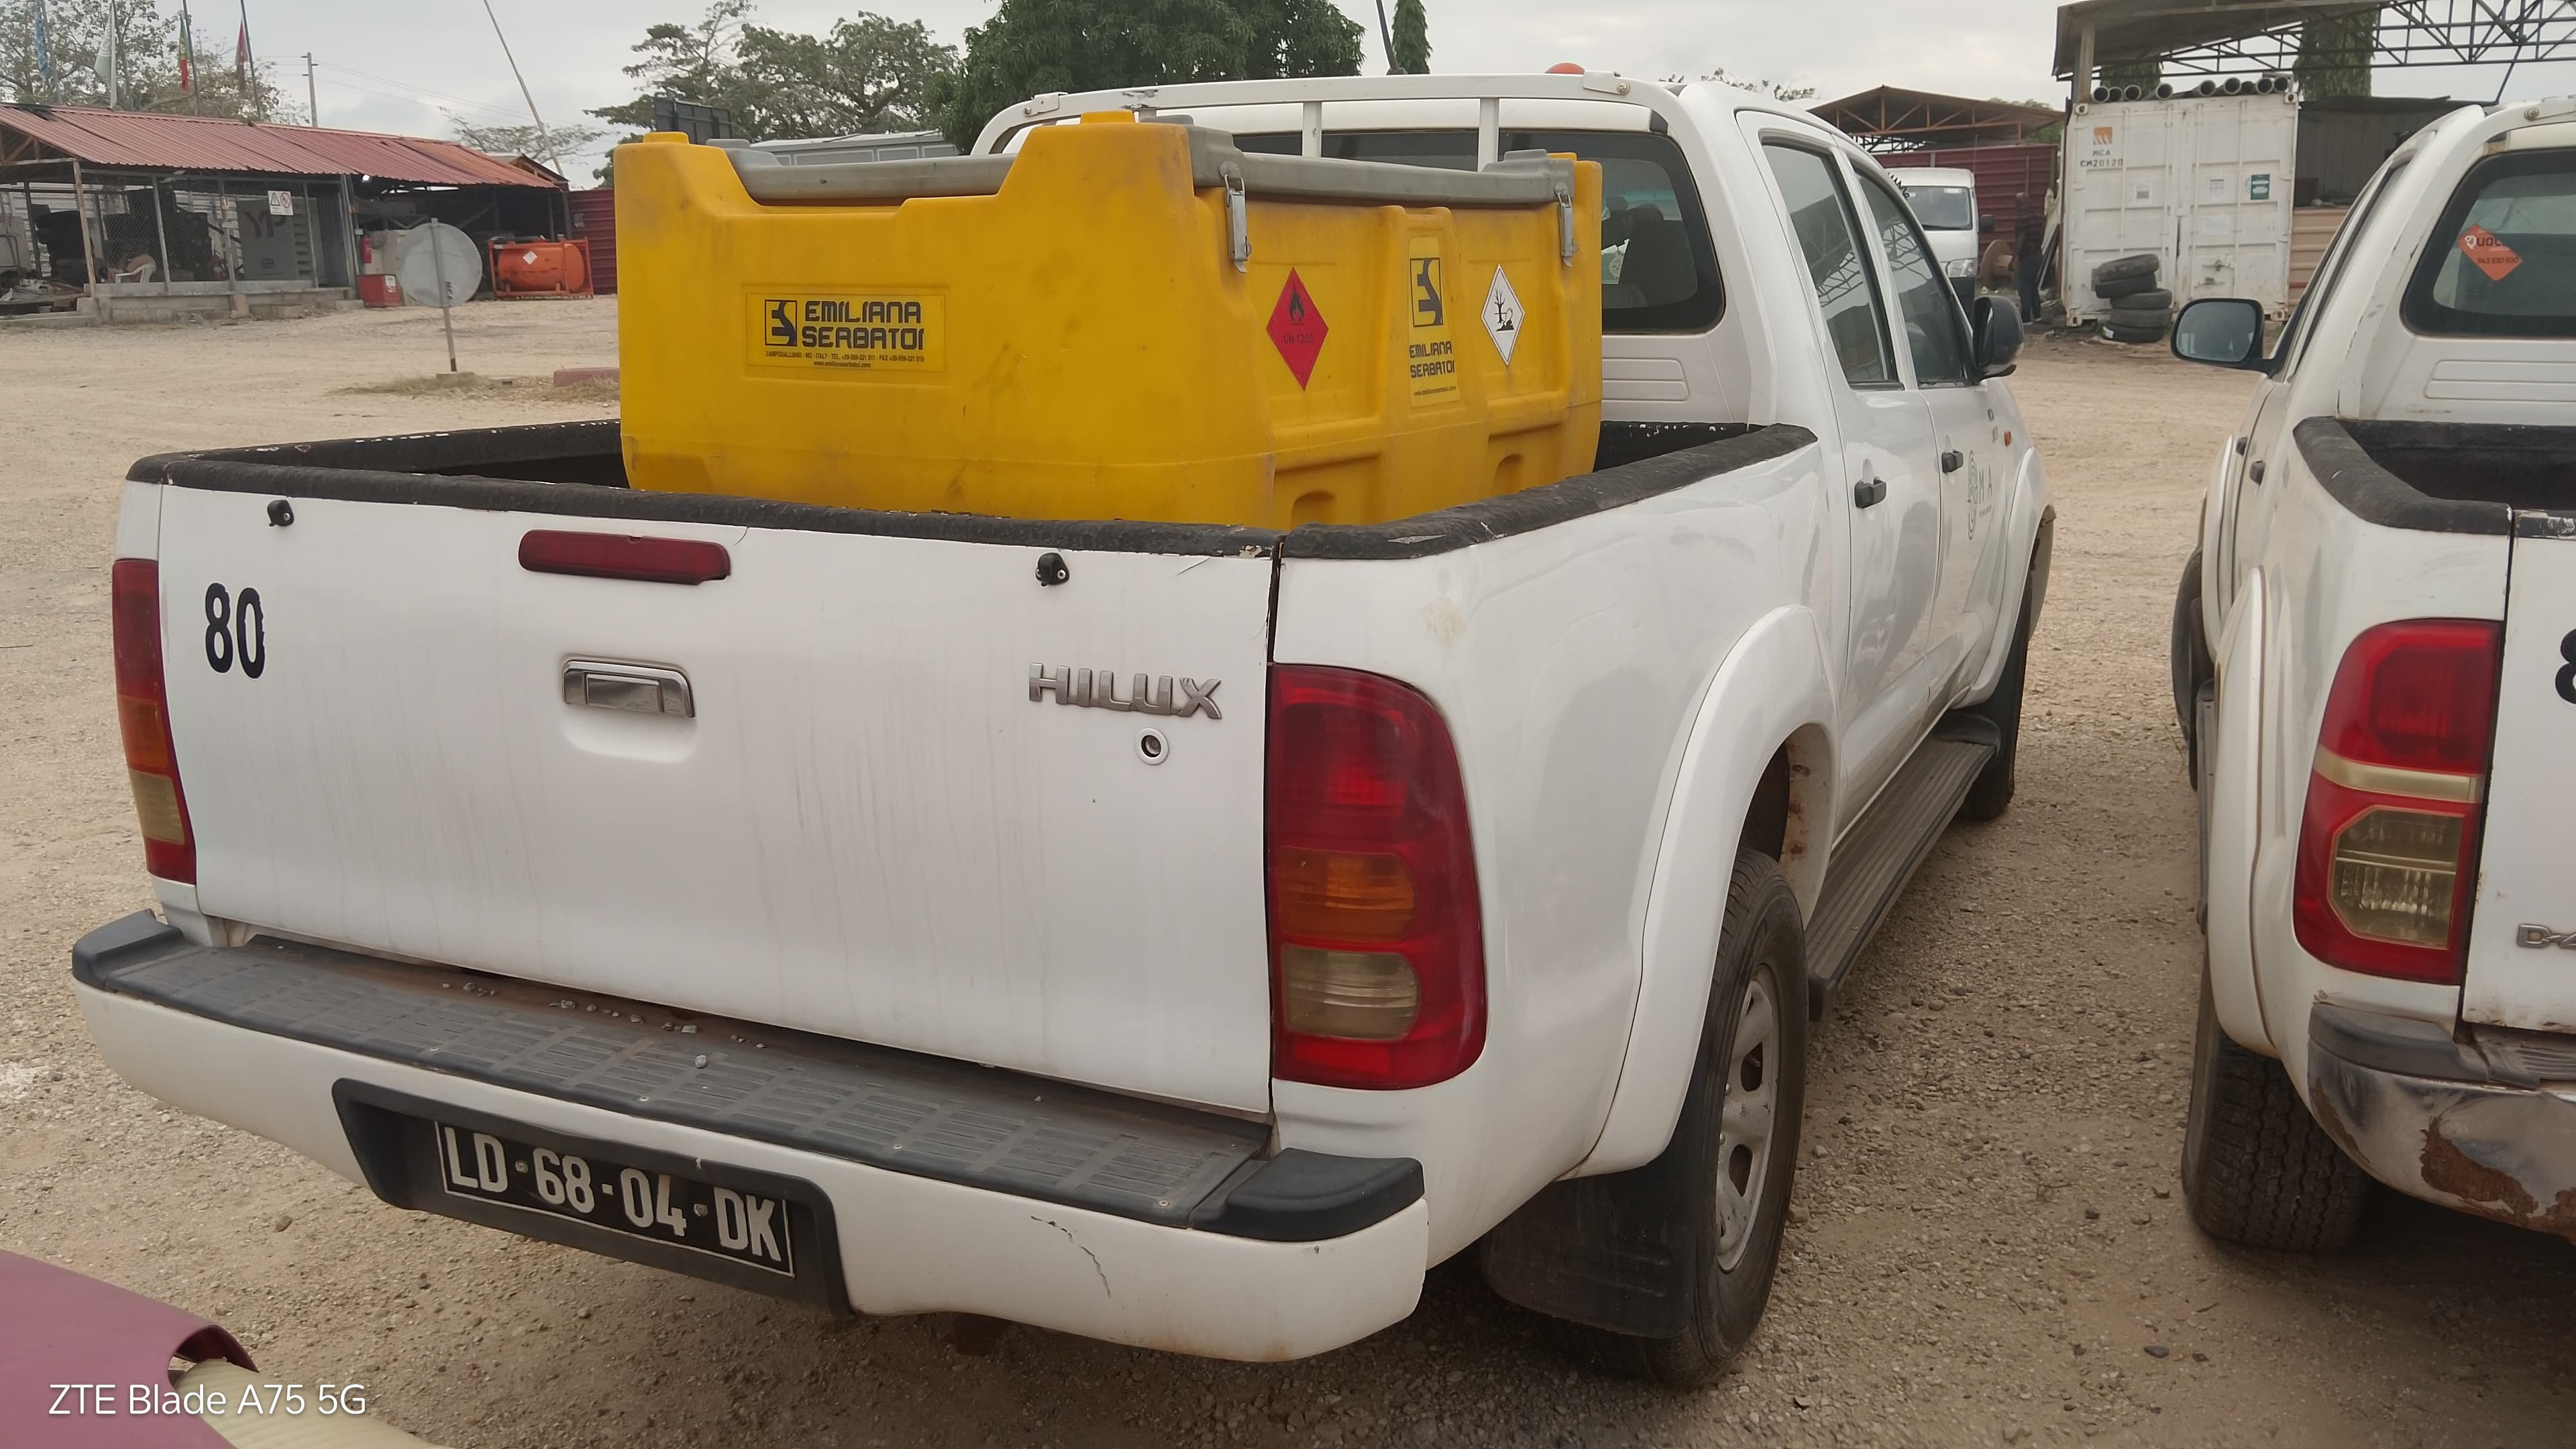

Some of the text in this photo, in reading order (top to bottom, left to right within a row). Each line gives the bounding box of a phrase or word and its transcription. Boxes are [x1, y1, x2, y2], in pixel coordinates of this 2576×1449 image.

[805, 301, 921, 323] EMILIANA
[802, 326, 924, 350] SERBATOI
[1409, 340, 1452, 358] EMILIANA
[1410, 360, 1455, 378] SERBATOI
[205, 582, 265, 679] 80
[1029, 662, 1222, 719] HILUX
